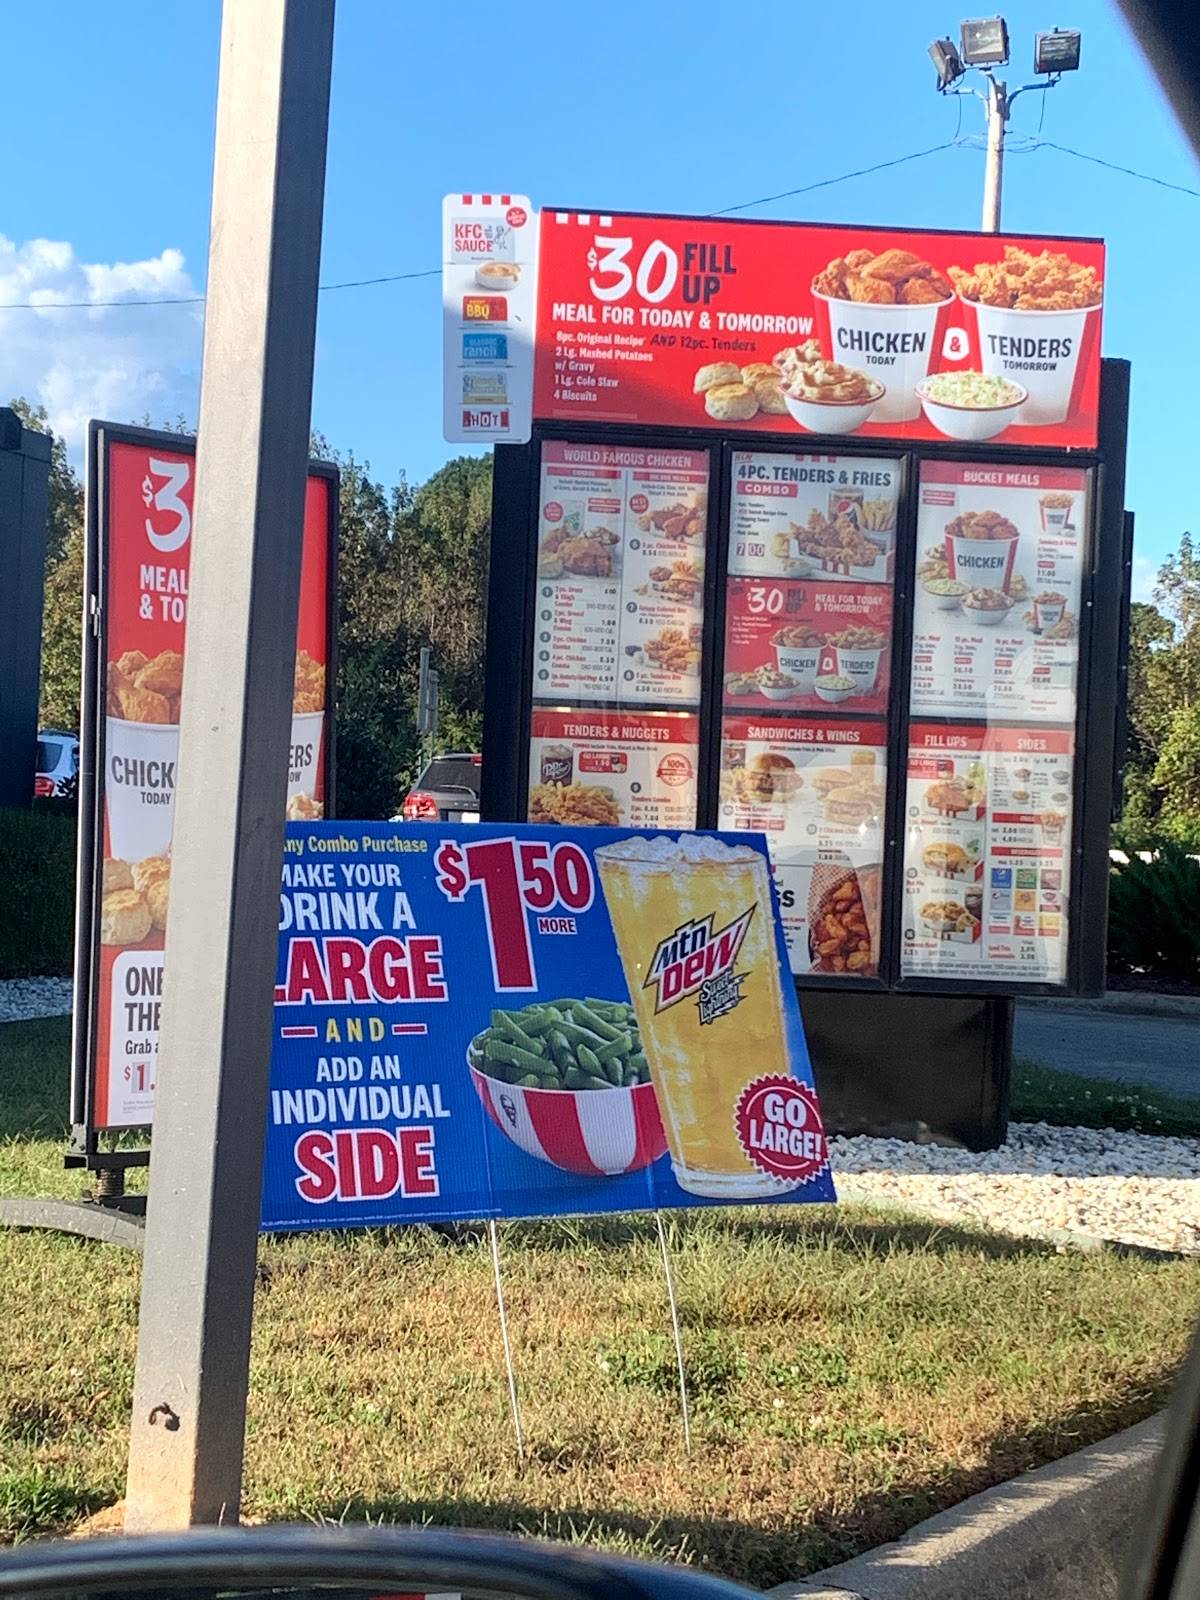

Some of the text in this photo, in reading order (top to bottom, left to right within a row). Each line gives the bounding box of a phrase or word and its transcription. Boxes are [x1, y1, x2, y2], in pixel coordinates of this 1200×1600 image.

[455, 223, 482, 239] KFC
[454, 240, 494, 252] SAUCE
[683, 243, 737, 274] FILL
[587, 234, 678, 303] $30
[682, 275, 721, 304] UP
[466, 304, 490, 319] BBQ
[552, 304, 814, 336] MEAL FOR TODAY & TOMORROW
[577, 332, 612, 346] Original
[650, 334, 756, 352] AND 12pc. Tenders
[837, 327, 926, 353] CHICKEN
[949, 335, 962, 352] &
[987, 333, 1073, 359] TENDERS
[464, 345, 497, 357] ranch
[556, 346, 562, 356] 2
[579, 348, 613, 360] Mashed
[614, 350, 653, 362] Potatoes
[568, 361, 595, 373] Gravy
[866, 355, 896, 367] TODAY
[1002, 359, 1057, 372] TOMORROW
[576, 376, 596, 387] Cole
[597, 377, 619, 388] Slaw
[553, 390, 597, 401] 4 Biscuits
[472, 411, 499, 427] HOT
[564, 449, 692, 467] WORLD FAMOUS CHICKEN
[738, 464, 891, 487] 4PC. TENDERS & FRIES
[963, 470, 1040, 486] BUCKET MEALS
[744, 484, 790, 495] COMBO
[957, 554, 1005, 569] CHICKEN
[140, 565, 188, 594] MEAL
[139, 593, 153, 620] &
[815, 593, 884, 605] MEAL FOR TODAY
[823, 603, 870, 614] TOMORROW
[780, 657, 816, 669] CHICKEN
[840, 659, 875, 670] TENDERS
[563, 723, 670, 740] TENDERS & NUGGETS
[747, 726, 860, 743] SANDWICHES & WINGS
[924, 734, 968, 748] FILL UPS
[1017, 738, 1047, 750] SIDES
[111, 755, 175, 788] CHICK
[141, 791, 171, 805] TODAY
[308, 835, 358, 853] Combo
[362, 835, 428, 854] Purchase
[339, 863, 402, 887] YOUR
[392, 891, 417, 930] A
[537, 916, 577, 935] MORE
[655, 925, 707, 974] Mtn
[325, 1018, 386, 1043] AND
[125, 1038, 152, 1055] Grab
[316, 1055, 401, 1082] ADD AN
[271, 1083, 451, 1125] INDIVIDUAL
[763, 1093, 807, 1128] GO
[750, 1118, 823, 1162] LARGE!
[294, 1125, 441, 1204] SIDE
